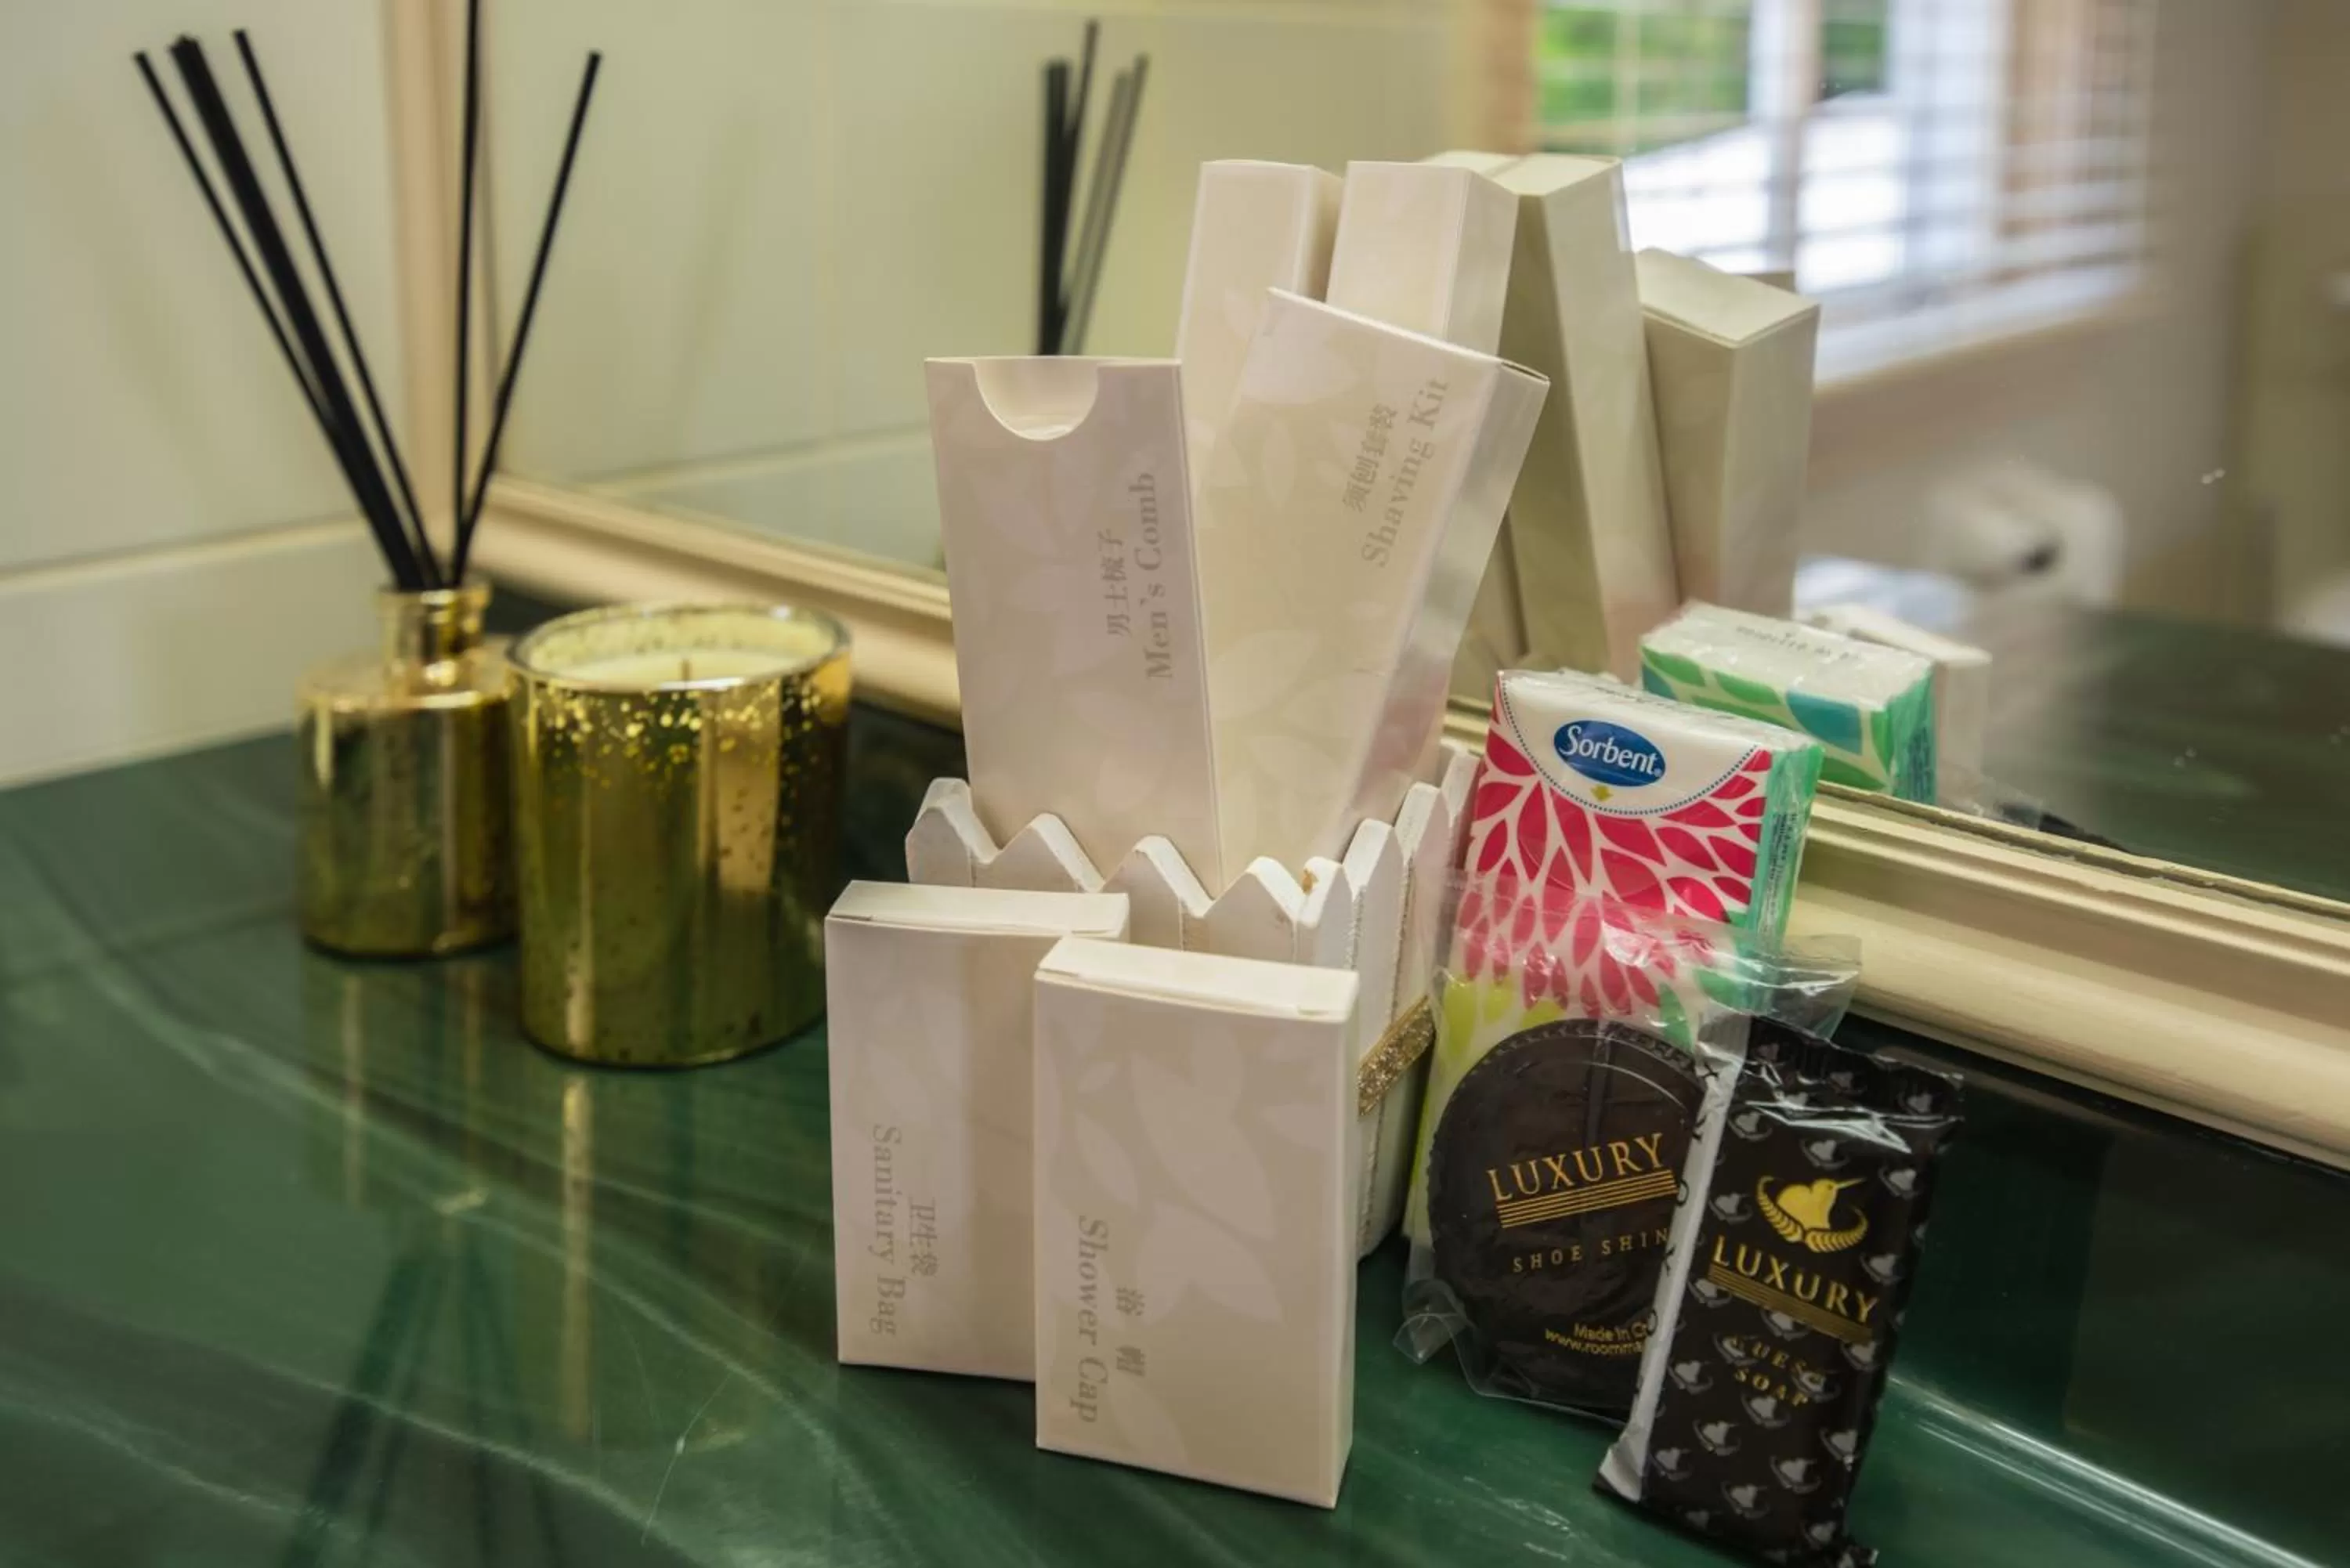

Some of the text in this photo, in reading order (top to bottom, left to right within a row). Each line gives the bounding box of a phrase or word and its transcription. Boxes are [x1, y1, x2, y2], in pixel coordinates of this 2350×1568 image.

[1361, 378, 1448, 568] Shaving Kit
[1128, 472, 1162, 571] Comb
[1558, 724, 1658, 775] Sorbent
[1487, 1133, 1663, 1201] LUXURY
[867, 1123, 906, 1336] Sanitary Bag
[908, 1196, 938, 1278] 卫生袋
[1513, 1227, 1670, 1273] SHOE SHIN
[1069, 1215, 1108, 1423] Shower Cap
[1712, 1234, 1879, 1324] LUXURY
[1574, 1322, 1613, 1342] Made
[1734, 1367, 1810, 1407] SOAP
